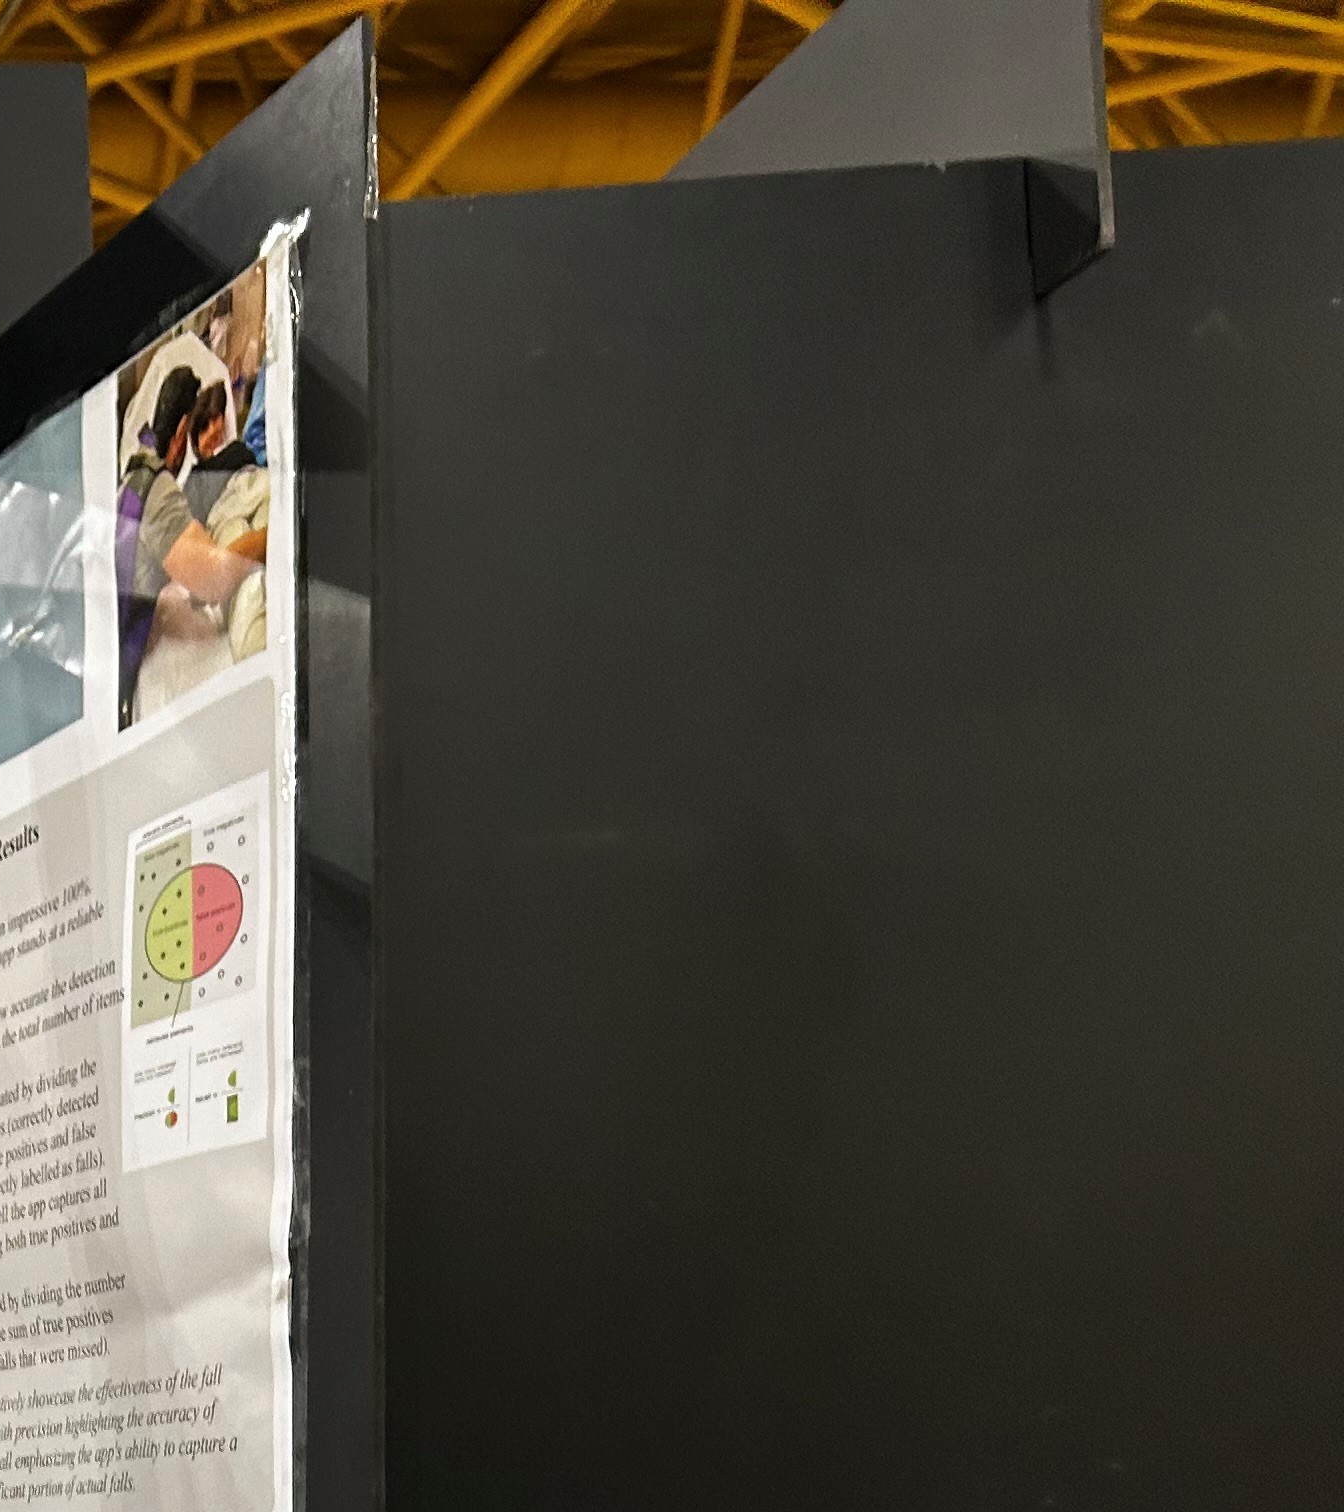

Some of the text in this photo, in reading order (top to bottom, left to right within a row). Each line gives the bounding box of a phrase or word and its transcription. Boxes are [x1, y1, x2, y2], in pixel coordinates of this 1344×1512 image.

[68, 958, 116, 991] detection
[48, 1178, 108, 1213] captures all
[50, 1205, 120, 1247] positives and
[126, 1397, 220, 1428] the accuracy of
[124, 1435, 238, 1463] ability to capture a
